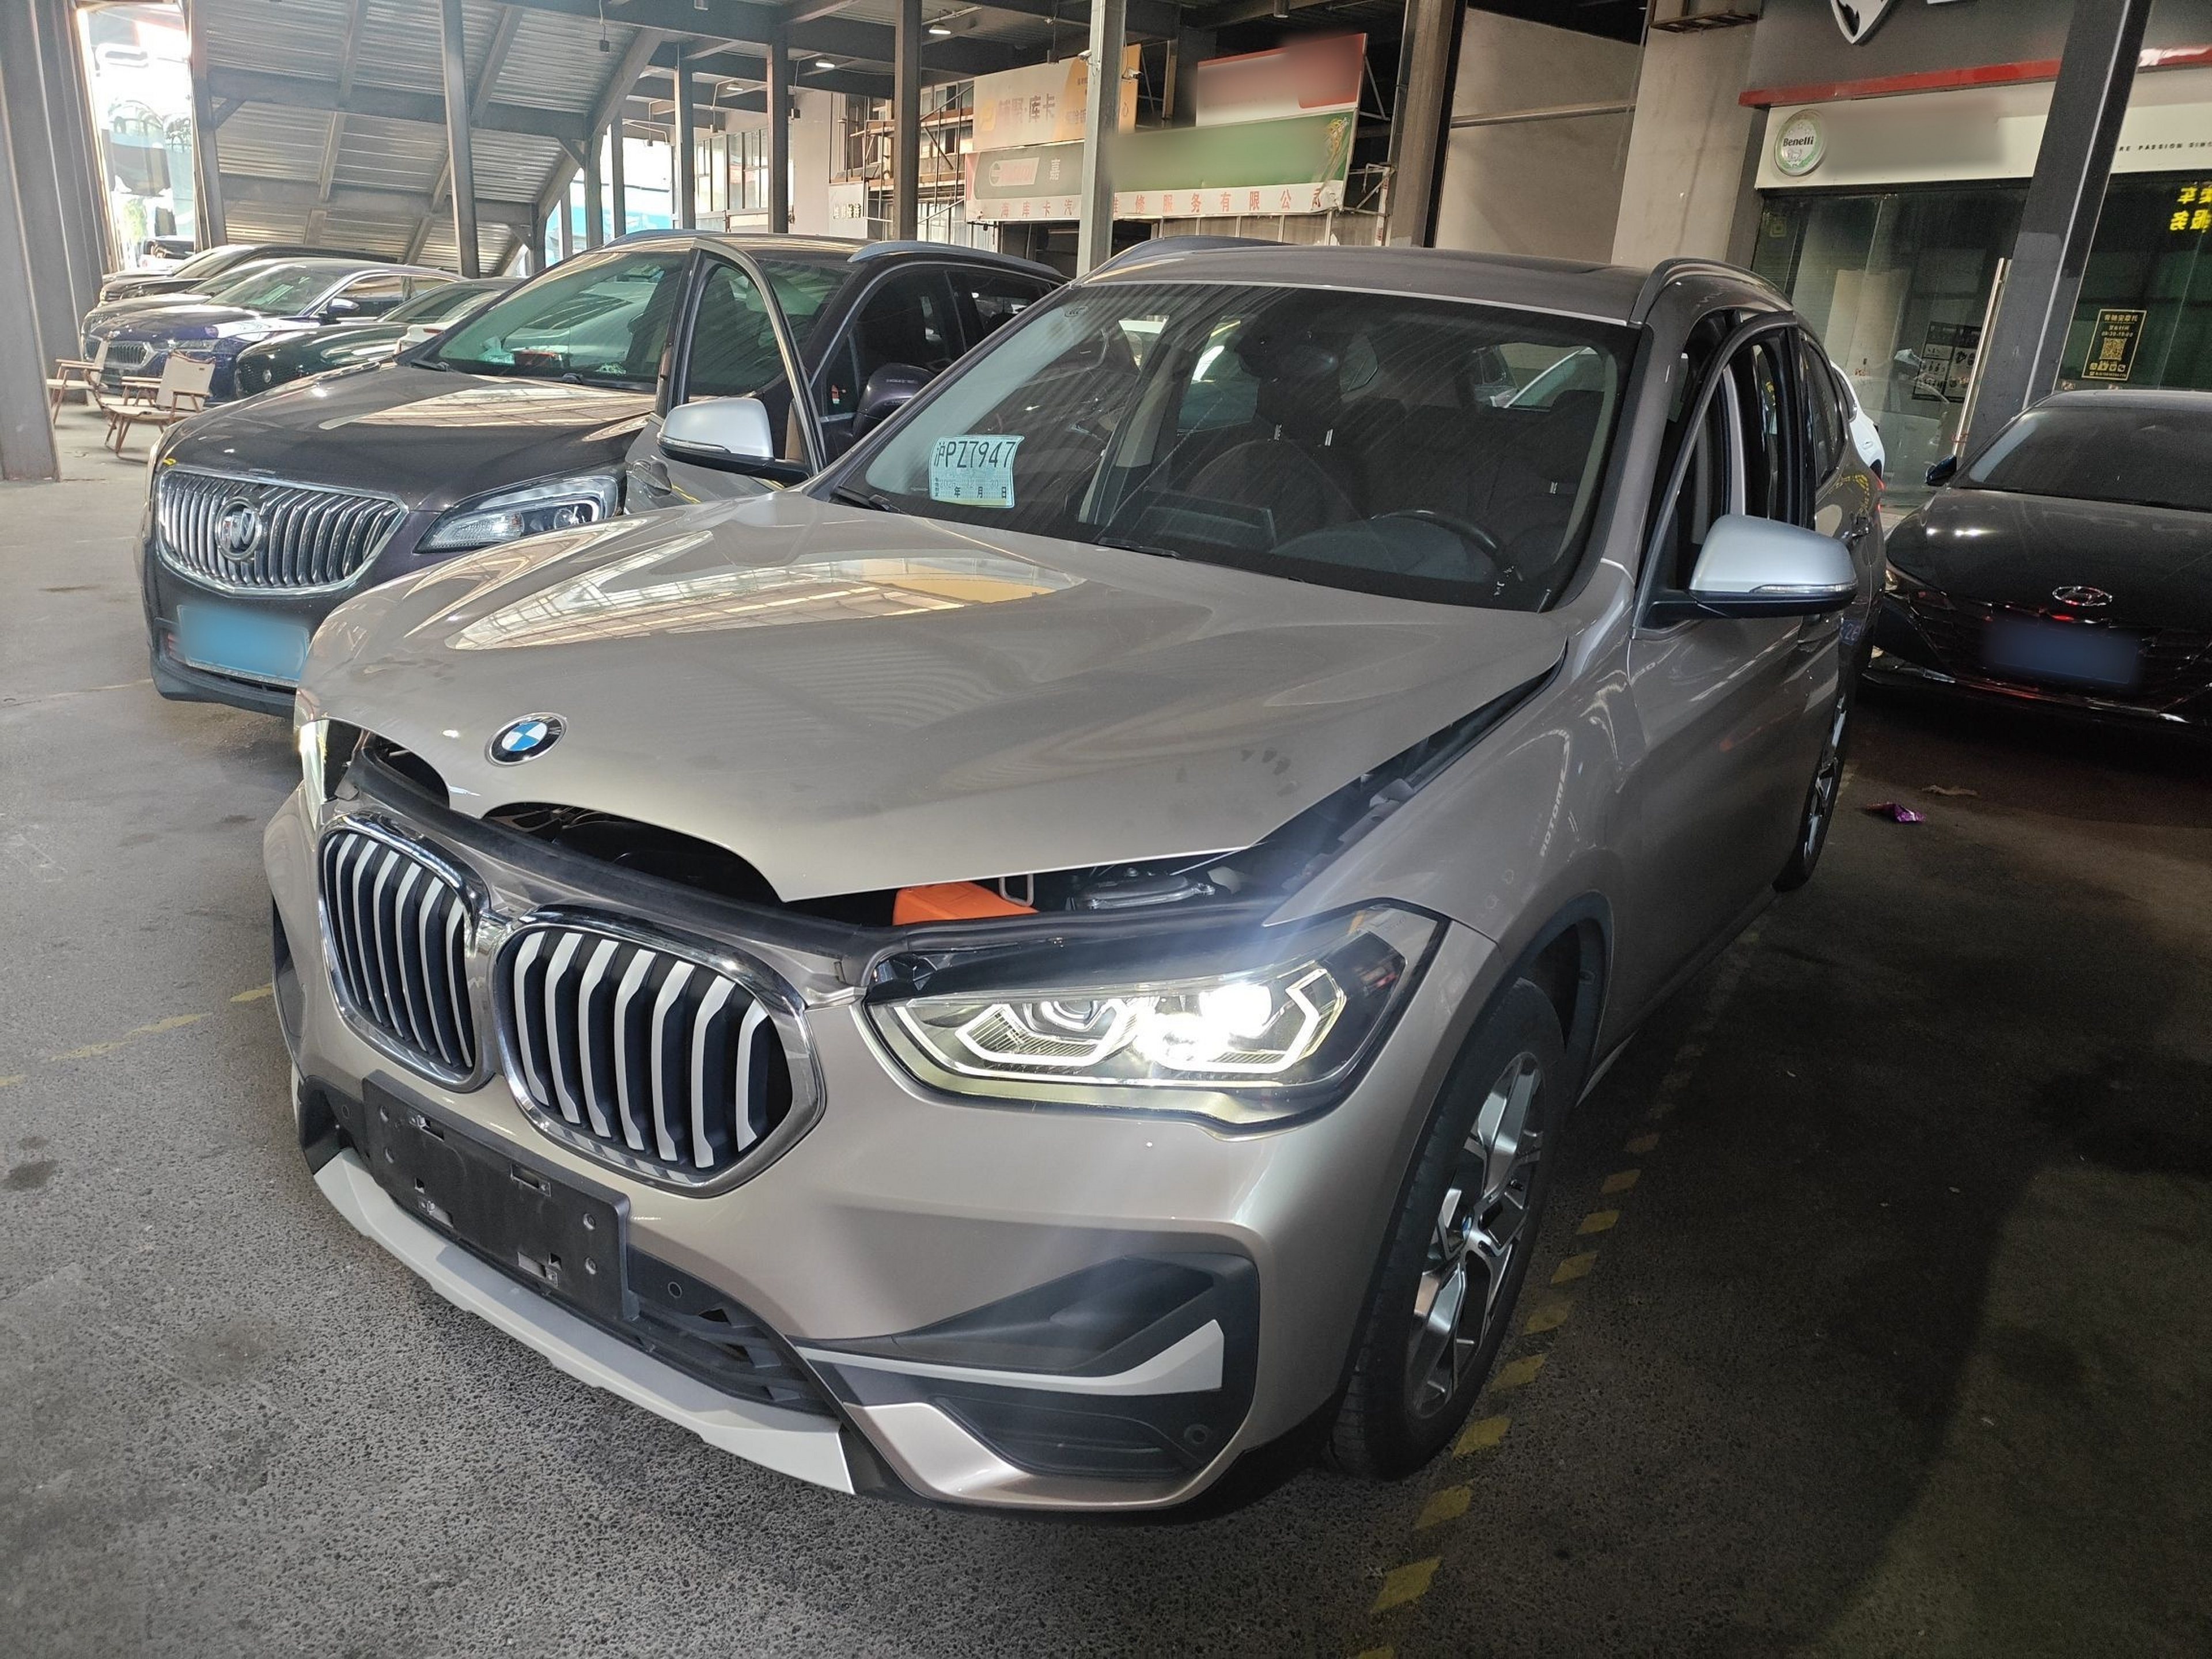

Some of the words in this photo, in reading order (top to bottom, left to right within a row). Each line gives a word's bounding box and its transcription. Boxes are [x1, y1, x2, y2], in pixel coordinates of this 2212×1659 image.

[1783, 136, 1814, 147] Benelli
[934, 441, 1016, 468] 沪PZ7947
[954, 487, 961, 498] 年
[977, 487, 983, 498] 月
[1001, 487, 1007, 498] 日
